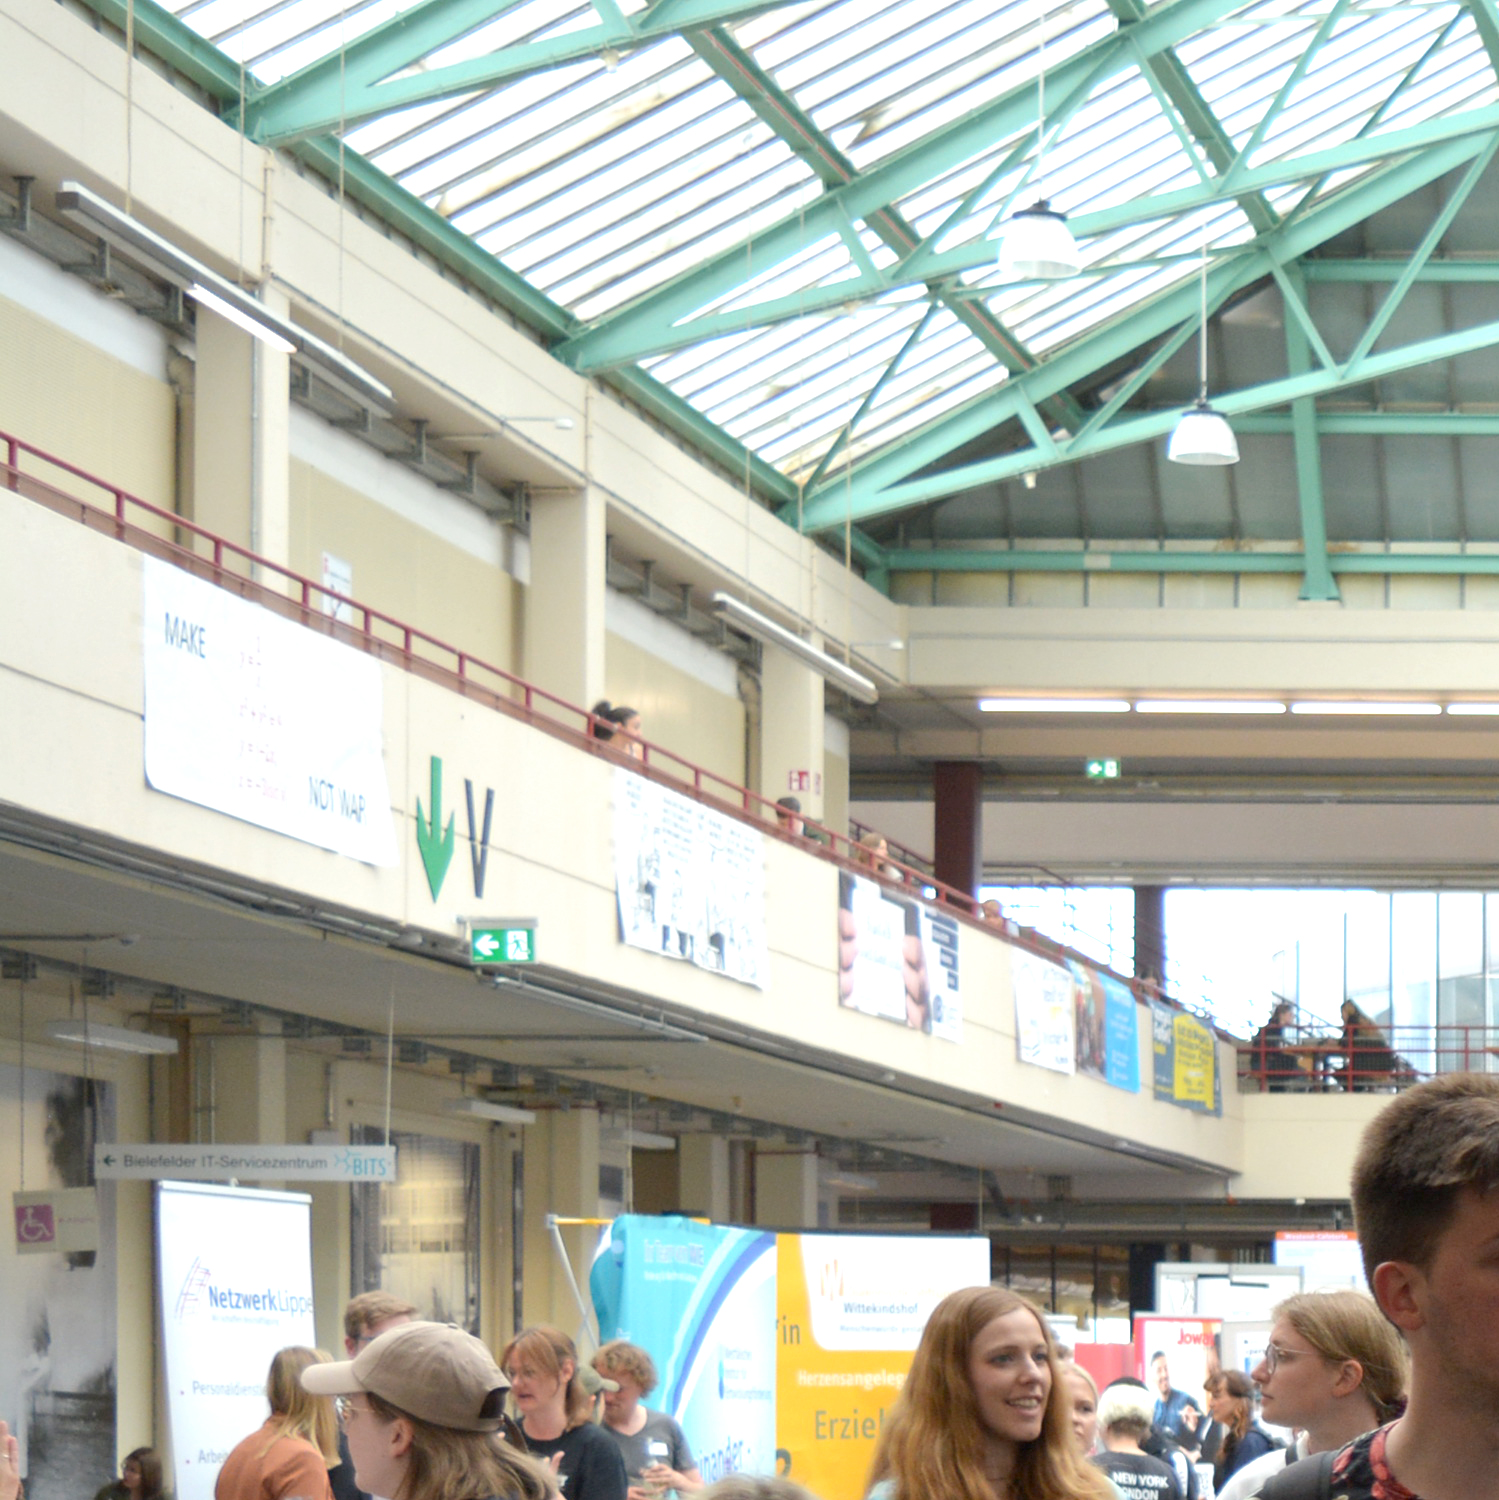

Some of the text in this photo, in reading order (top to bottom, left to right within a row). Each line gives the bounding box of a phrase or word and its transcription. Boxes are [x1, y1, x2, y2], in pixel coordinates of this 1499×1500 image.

[165, 612, 206, 659] MAKE
[309, 775, 334, 815] NOT
[463, 777, 495, 900] V
[123, 1154, 387, 1176] Bielefelder IT-Servicezentrum BITS
[843, 1302, 918, 1315] Wittekindshof
[1112, 1471, 1169, 1488] NEW YORK
